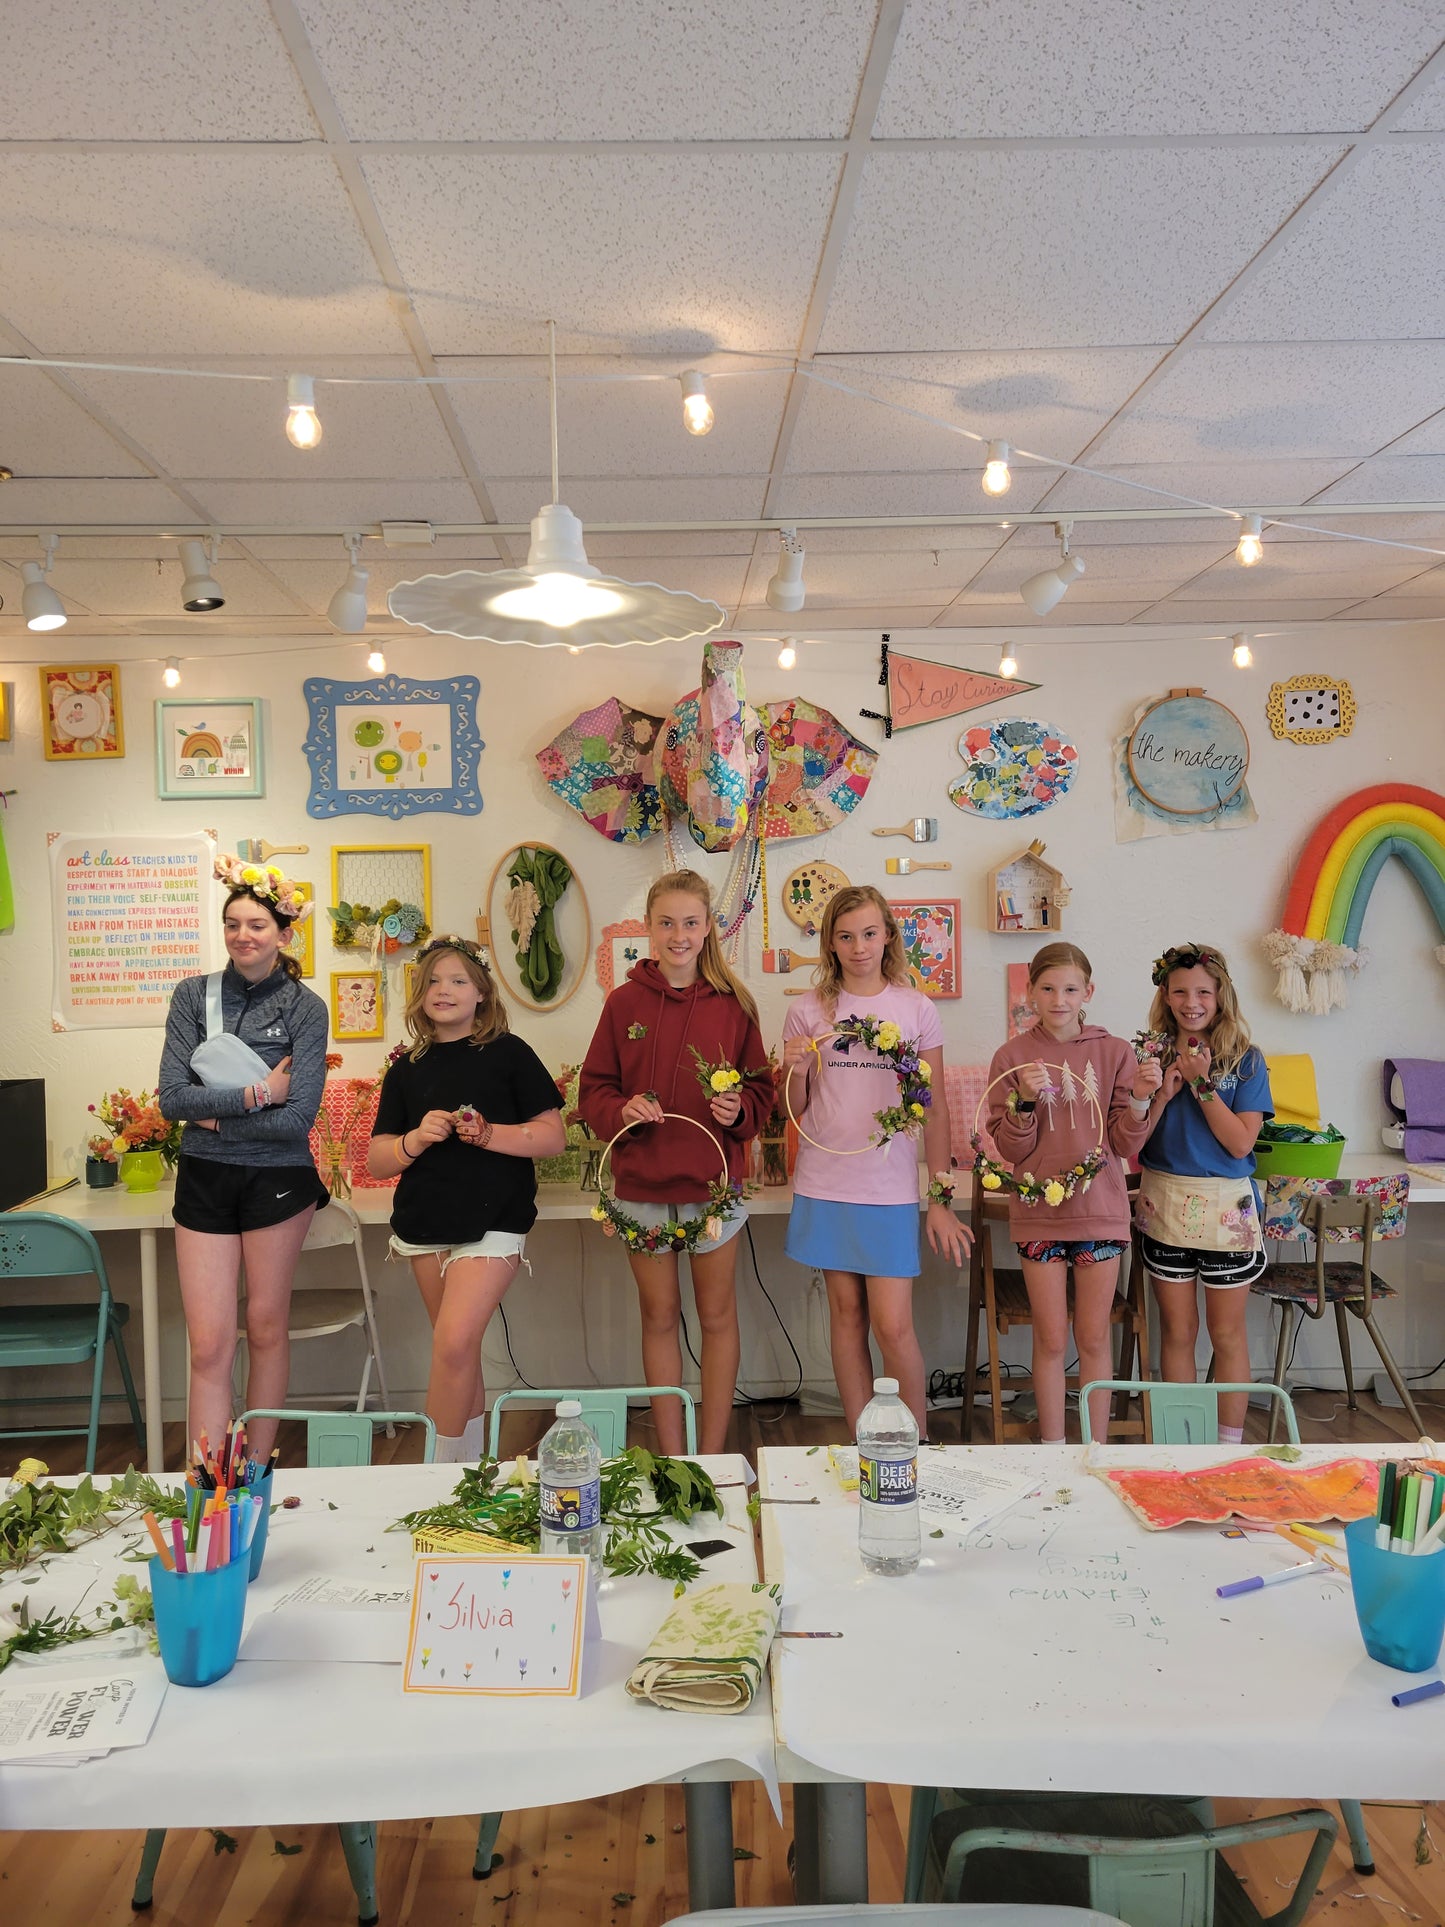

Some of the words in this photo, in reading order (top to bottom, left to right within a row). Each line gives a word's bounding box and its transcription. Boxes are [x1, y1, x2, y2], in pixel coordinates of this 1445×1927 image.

[897, 663, 959, 716] Stay
[1133, 732, 1164, 762] the
[1173, 743, 1247, 787] makery
[67, 850, 91, 866] art
[93, 849, 130, 866] class
[132, 856, 166, 865] TEACHES
[168, 855, 186, 864] KIDS
[188, 855, 198, 863] TO
[67, 871, 96, 879] RESPECT
[98, 870, 123, 878] OTHERS
[127, 868, 151, 878] START
[152, 869, 158, 877] A
[160, 866, 198, 877] DIALOGUE
[67, 883, 107, 891] EXPERIMENT
[164, 879, 198, 889] OBSERVE
[67, 896, 85, 904] FIND
[88, 895, 111, 904] THEIR
[113, 895, 136, 904] VOICE
[139, 893, 199, 903] SELF-EVALUATE
[85, 908, 126, 916] CONNECTIONS
[128, 907, 156, 915] EXPRESS
[158, 906, 198, 915] THEMSELVES
[67, 921, 96, 931] LEARN
[100, 921, 124, 930] FROM
[127, 920, 152, 930] THEIR
[156, 918, 200, 929] MISTAKES
[68, 936, 90, 944] CLEAN
[92, 936, 101, 944] UP
[105, 934, 137, 944] REFLECT
[140, 932, 151, 941] ON
[153, 931, 175, 940] THEIR
[178, 931, 200, 940] WORK
[68, 948, 106, 957] EMBRACE
[108, 946, 148, 956] DIVERSITY
[151, 944, 200, 954] PERSEVERE
[125, 958, 171, 968] APPRECIATE
[172, 957, 201, 966] BEAUTY
[70, 973, 96, 983] BREAK
[99, 972, 120, 982] AWAY
[122, 971, 145, 980] FROM
[147, 969, 202, 980] STEREOTYPES
[71, 986, 100, 994] ENVISION
[102, 985, 136, 993] SOLUTIONS
[138, 983, 160, 991] VALUE
[71, 998, 83, 1006] SEE
[85, 997, 114, 1006] ANOTHER
[116, 997, 135, 1005] POINT
[137, 996, 144, 1004] OF
[146, 996, 162, 1004] VIEW
[880, 1464, 913, 1477] DEER
[880, 1476, 914, 1489] PARK
[541, 1487, 558, 1503] EER
[541, 1499, 559, 1515] ARK
[417, 1531, 449, 1542] DESIGN
[415, 1538, 434, 1553] Fitz
[439, 1582, 513, 1630] Silvia
[105, 1678, 134, 1702] Camp
[46, 1690, 88, 1738] POWER
